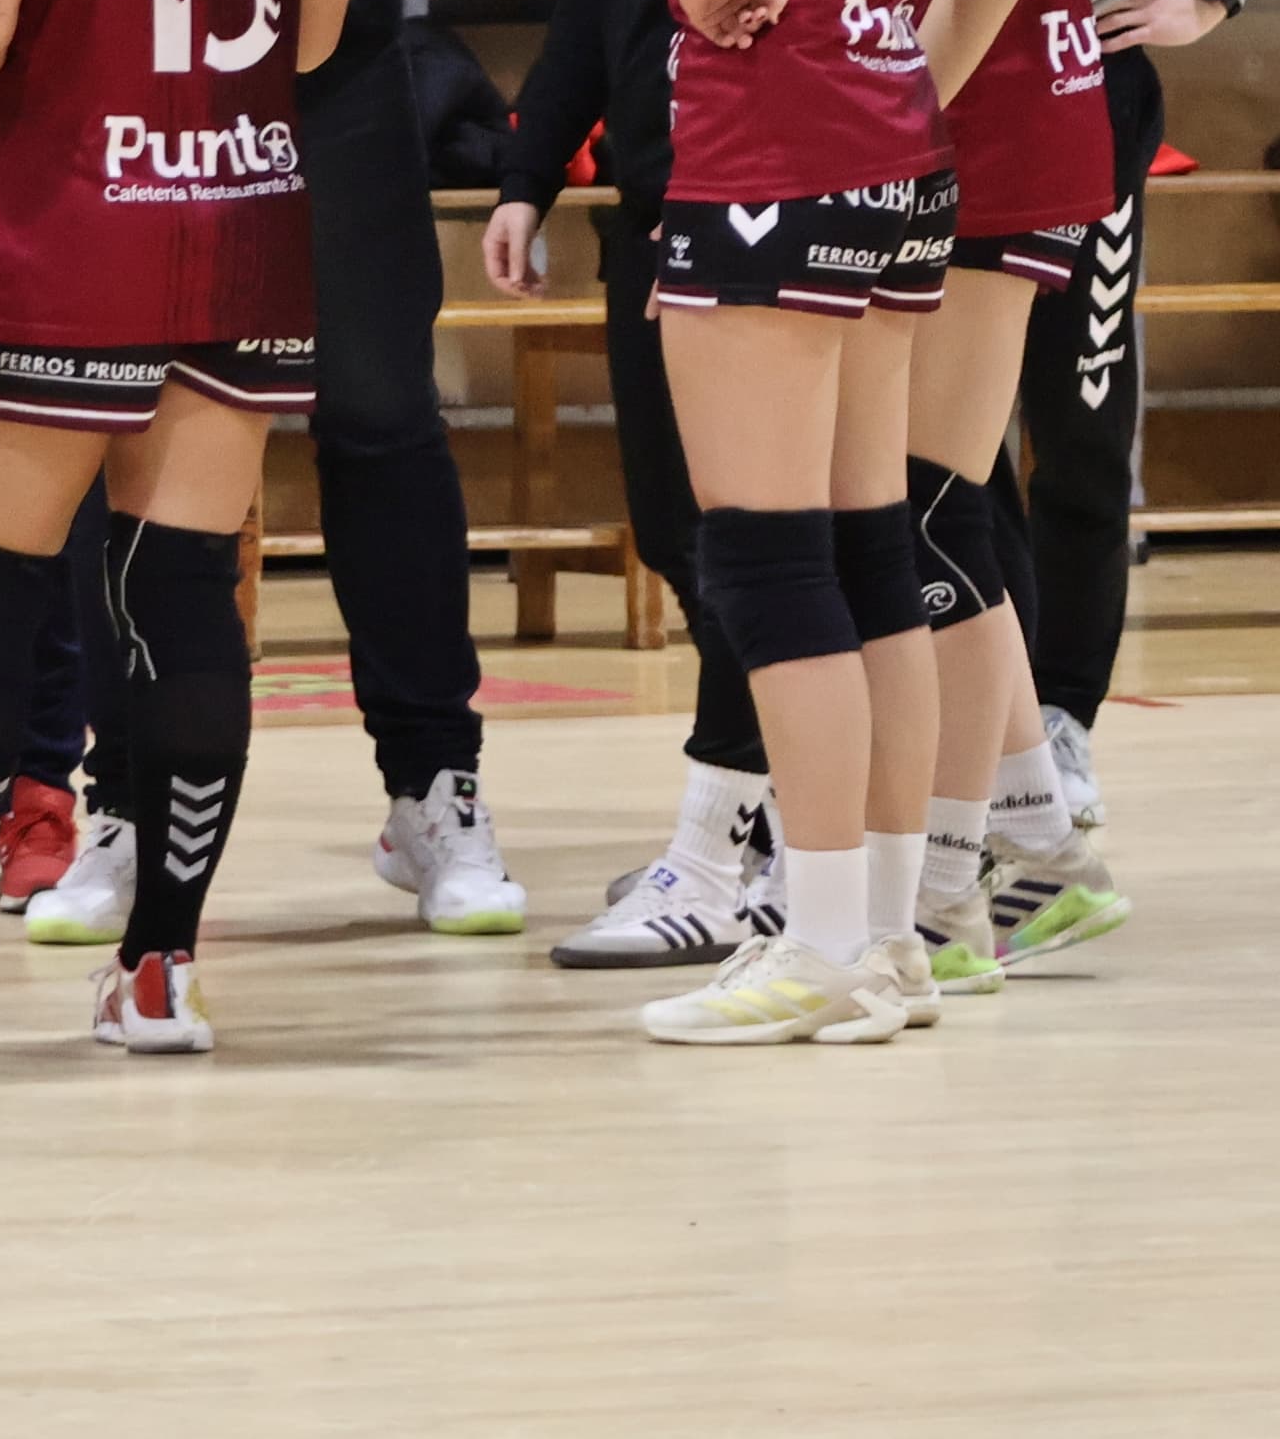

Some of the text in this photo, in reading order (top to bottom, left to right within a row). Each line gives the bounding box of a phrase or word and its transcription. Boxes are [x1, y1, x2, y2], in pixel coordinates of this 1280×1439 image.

[807, 243, 878, 269] FERROS
[894, 234, 956, 265] Diss
[0, 350, 76, 377] FERROS
[990, 791, 1053, 811] adidas
